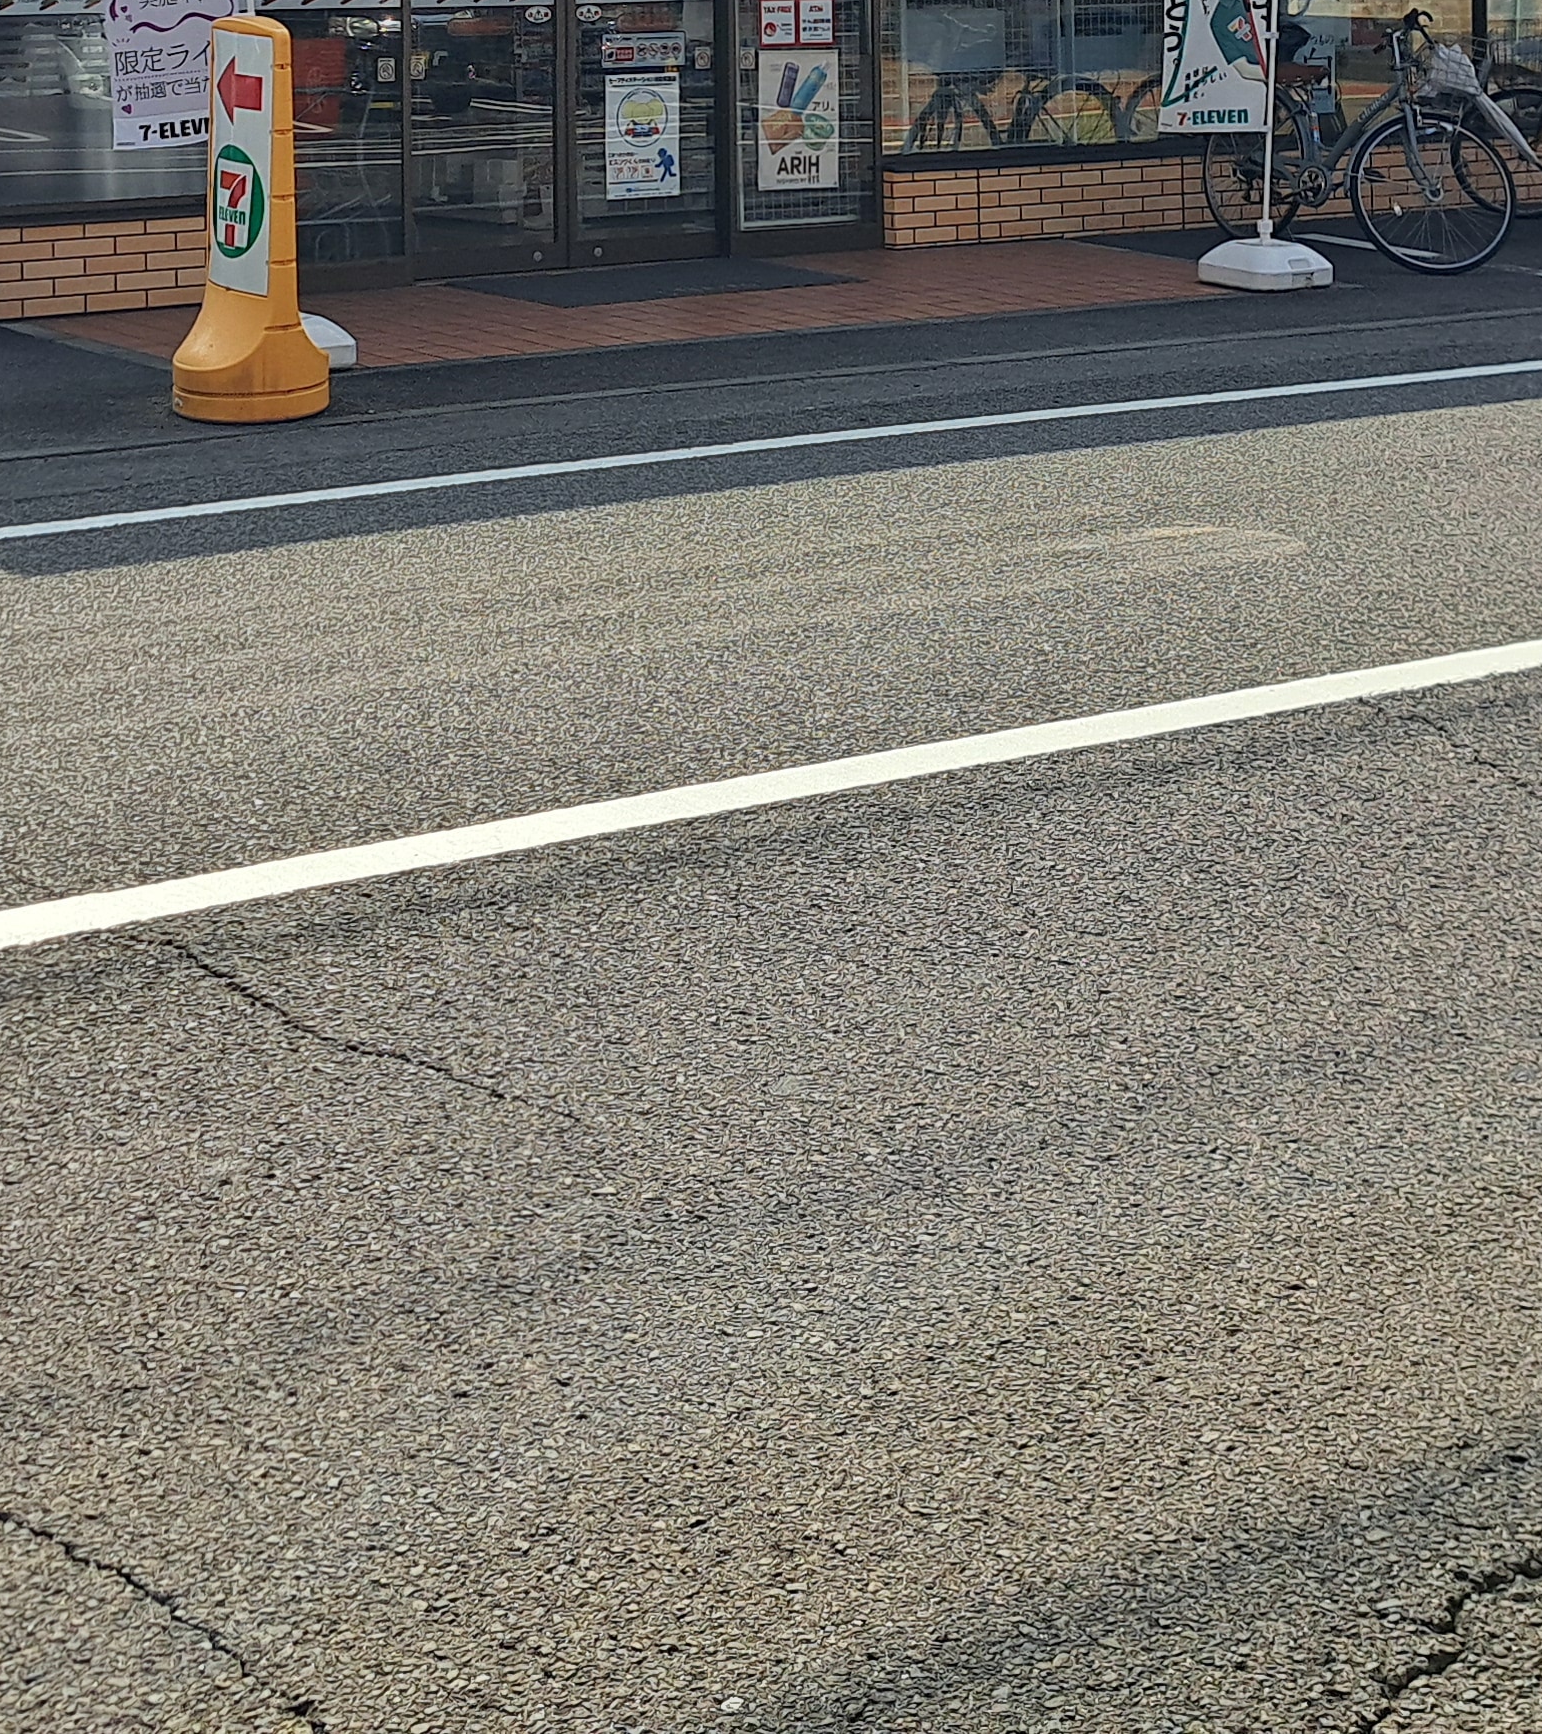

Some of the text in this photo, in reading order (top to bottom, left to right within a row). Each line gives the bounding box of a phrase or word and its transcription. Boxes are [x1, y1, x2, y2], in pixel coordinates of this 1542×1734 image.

[114, 41, 211, 77] 限定ライ
[139, 116, 210, 142] 7-ELEV
[220, 170, 247, 248] 7
